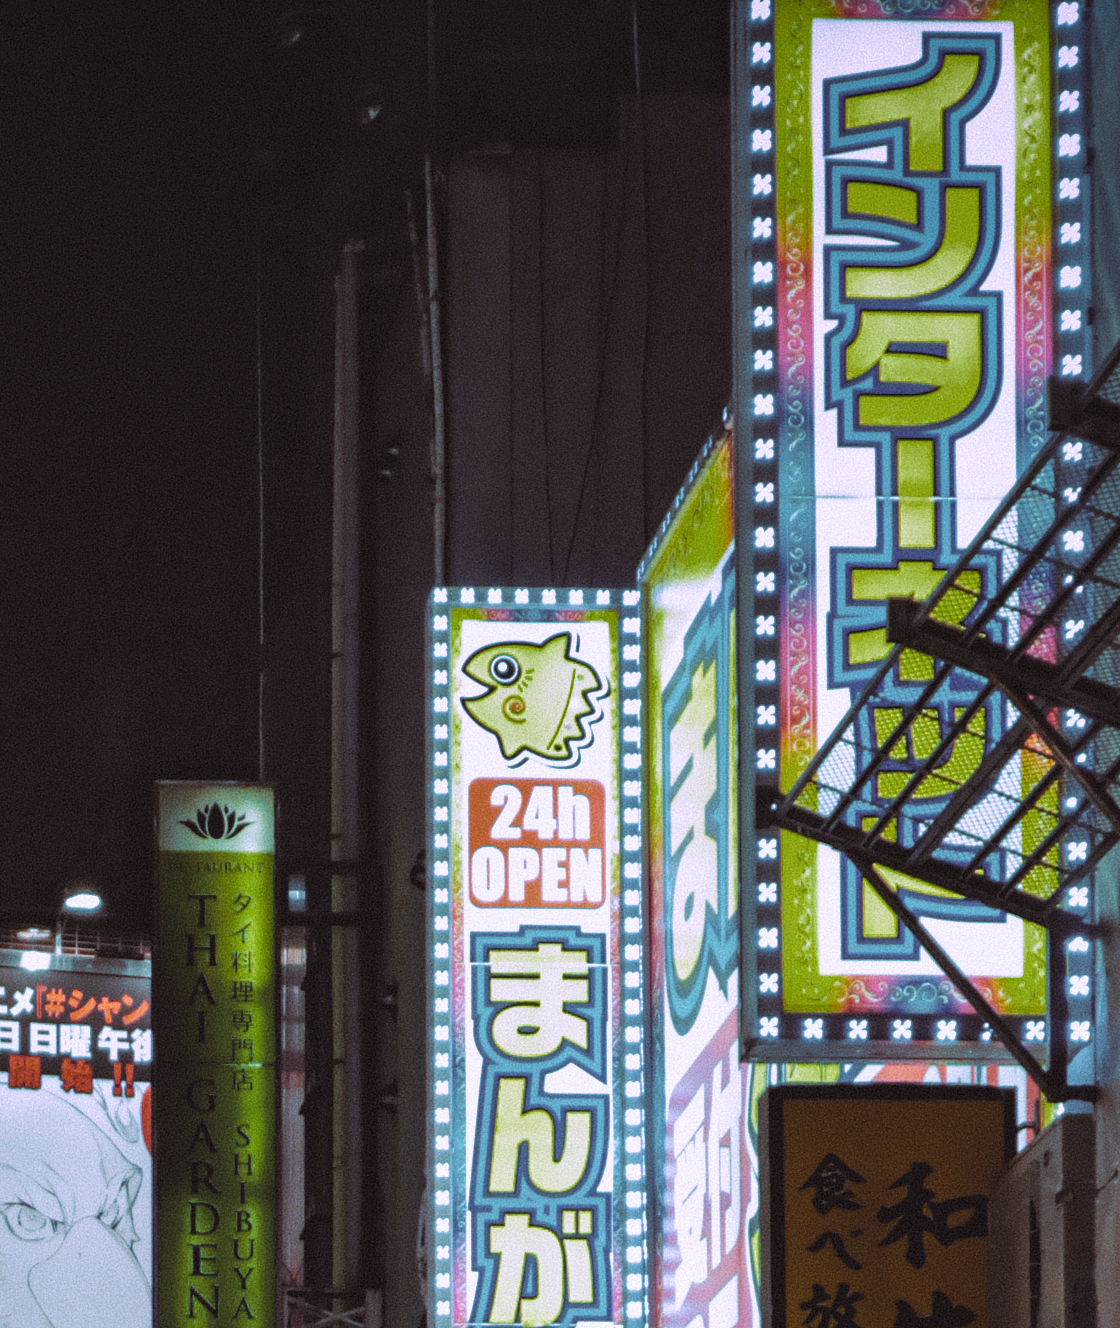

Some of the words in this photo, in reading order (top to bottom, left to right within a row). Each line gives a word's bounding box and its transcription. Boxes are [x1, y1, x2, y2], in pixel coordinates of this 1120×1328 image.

[471, 846, 603, 902] OPEN
[490, 784, 591, 840] 24h
[186, 893, 217, 1044] THAI
[232, 892, 254, 1091] タイ料理専門店
[186, 1079, 221, 1319] GARDEN
[233, 1123, 255, 1320] SHIBUYA
